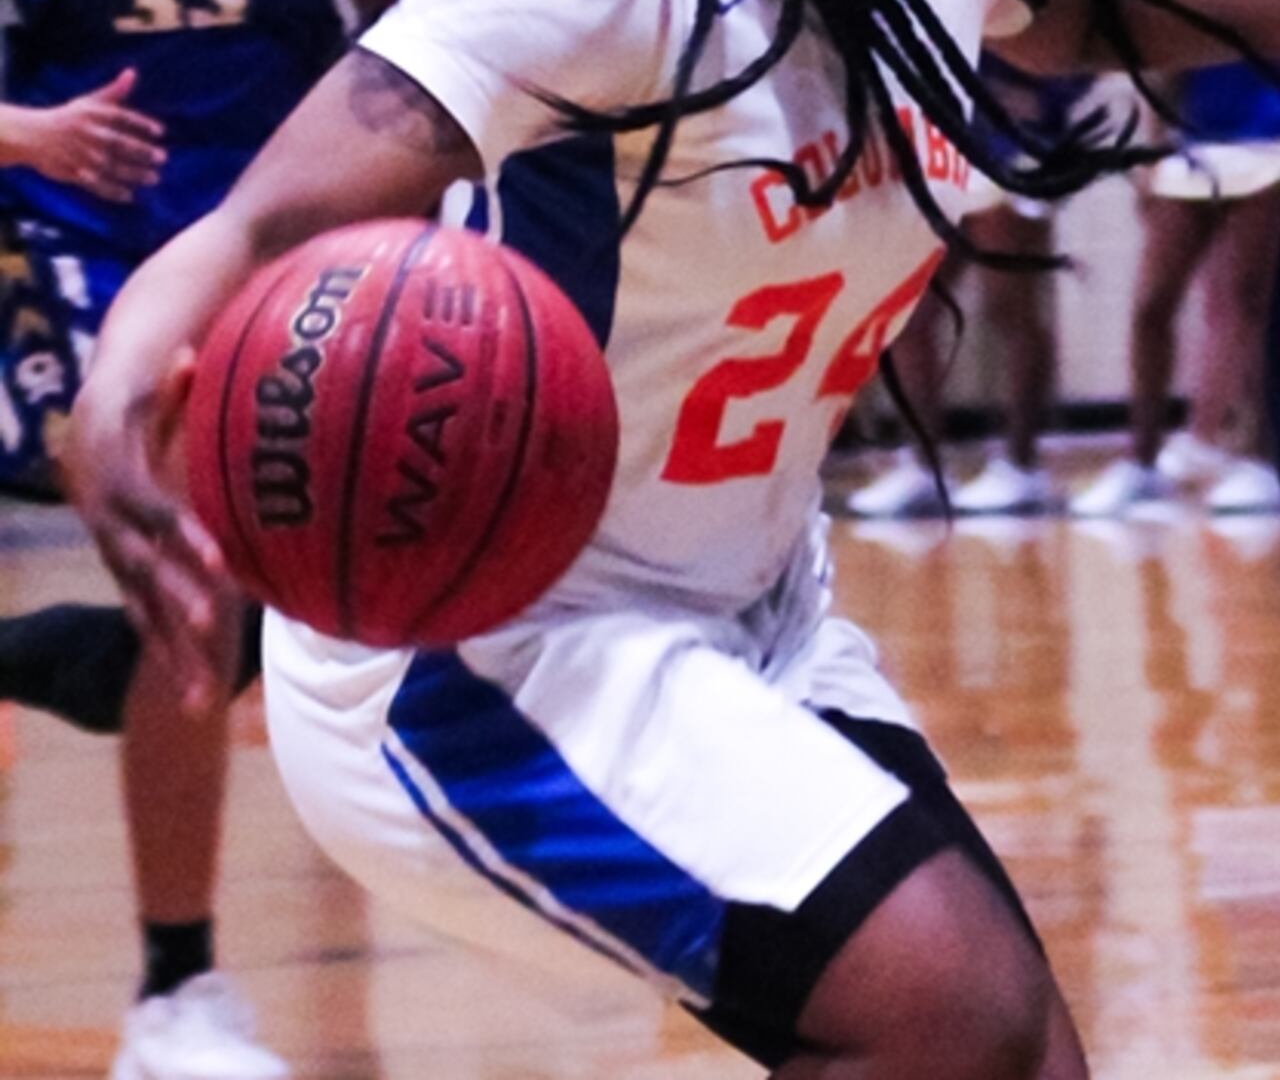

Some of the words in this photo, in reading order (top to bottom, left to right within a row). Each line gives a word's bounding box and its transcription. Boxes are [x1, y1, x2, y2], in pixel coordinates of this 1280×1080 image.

[251, 262, 372, 530] Wilson
[375, 277, 480, 549] WAVE
[660, 246, 946, 485] 24
